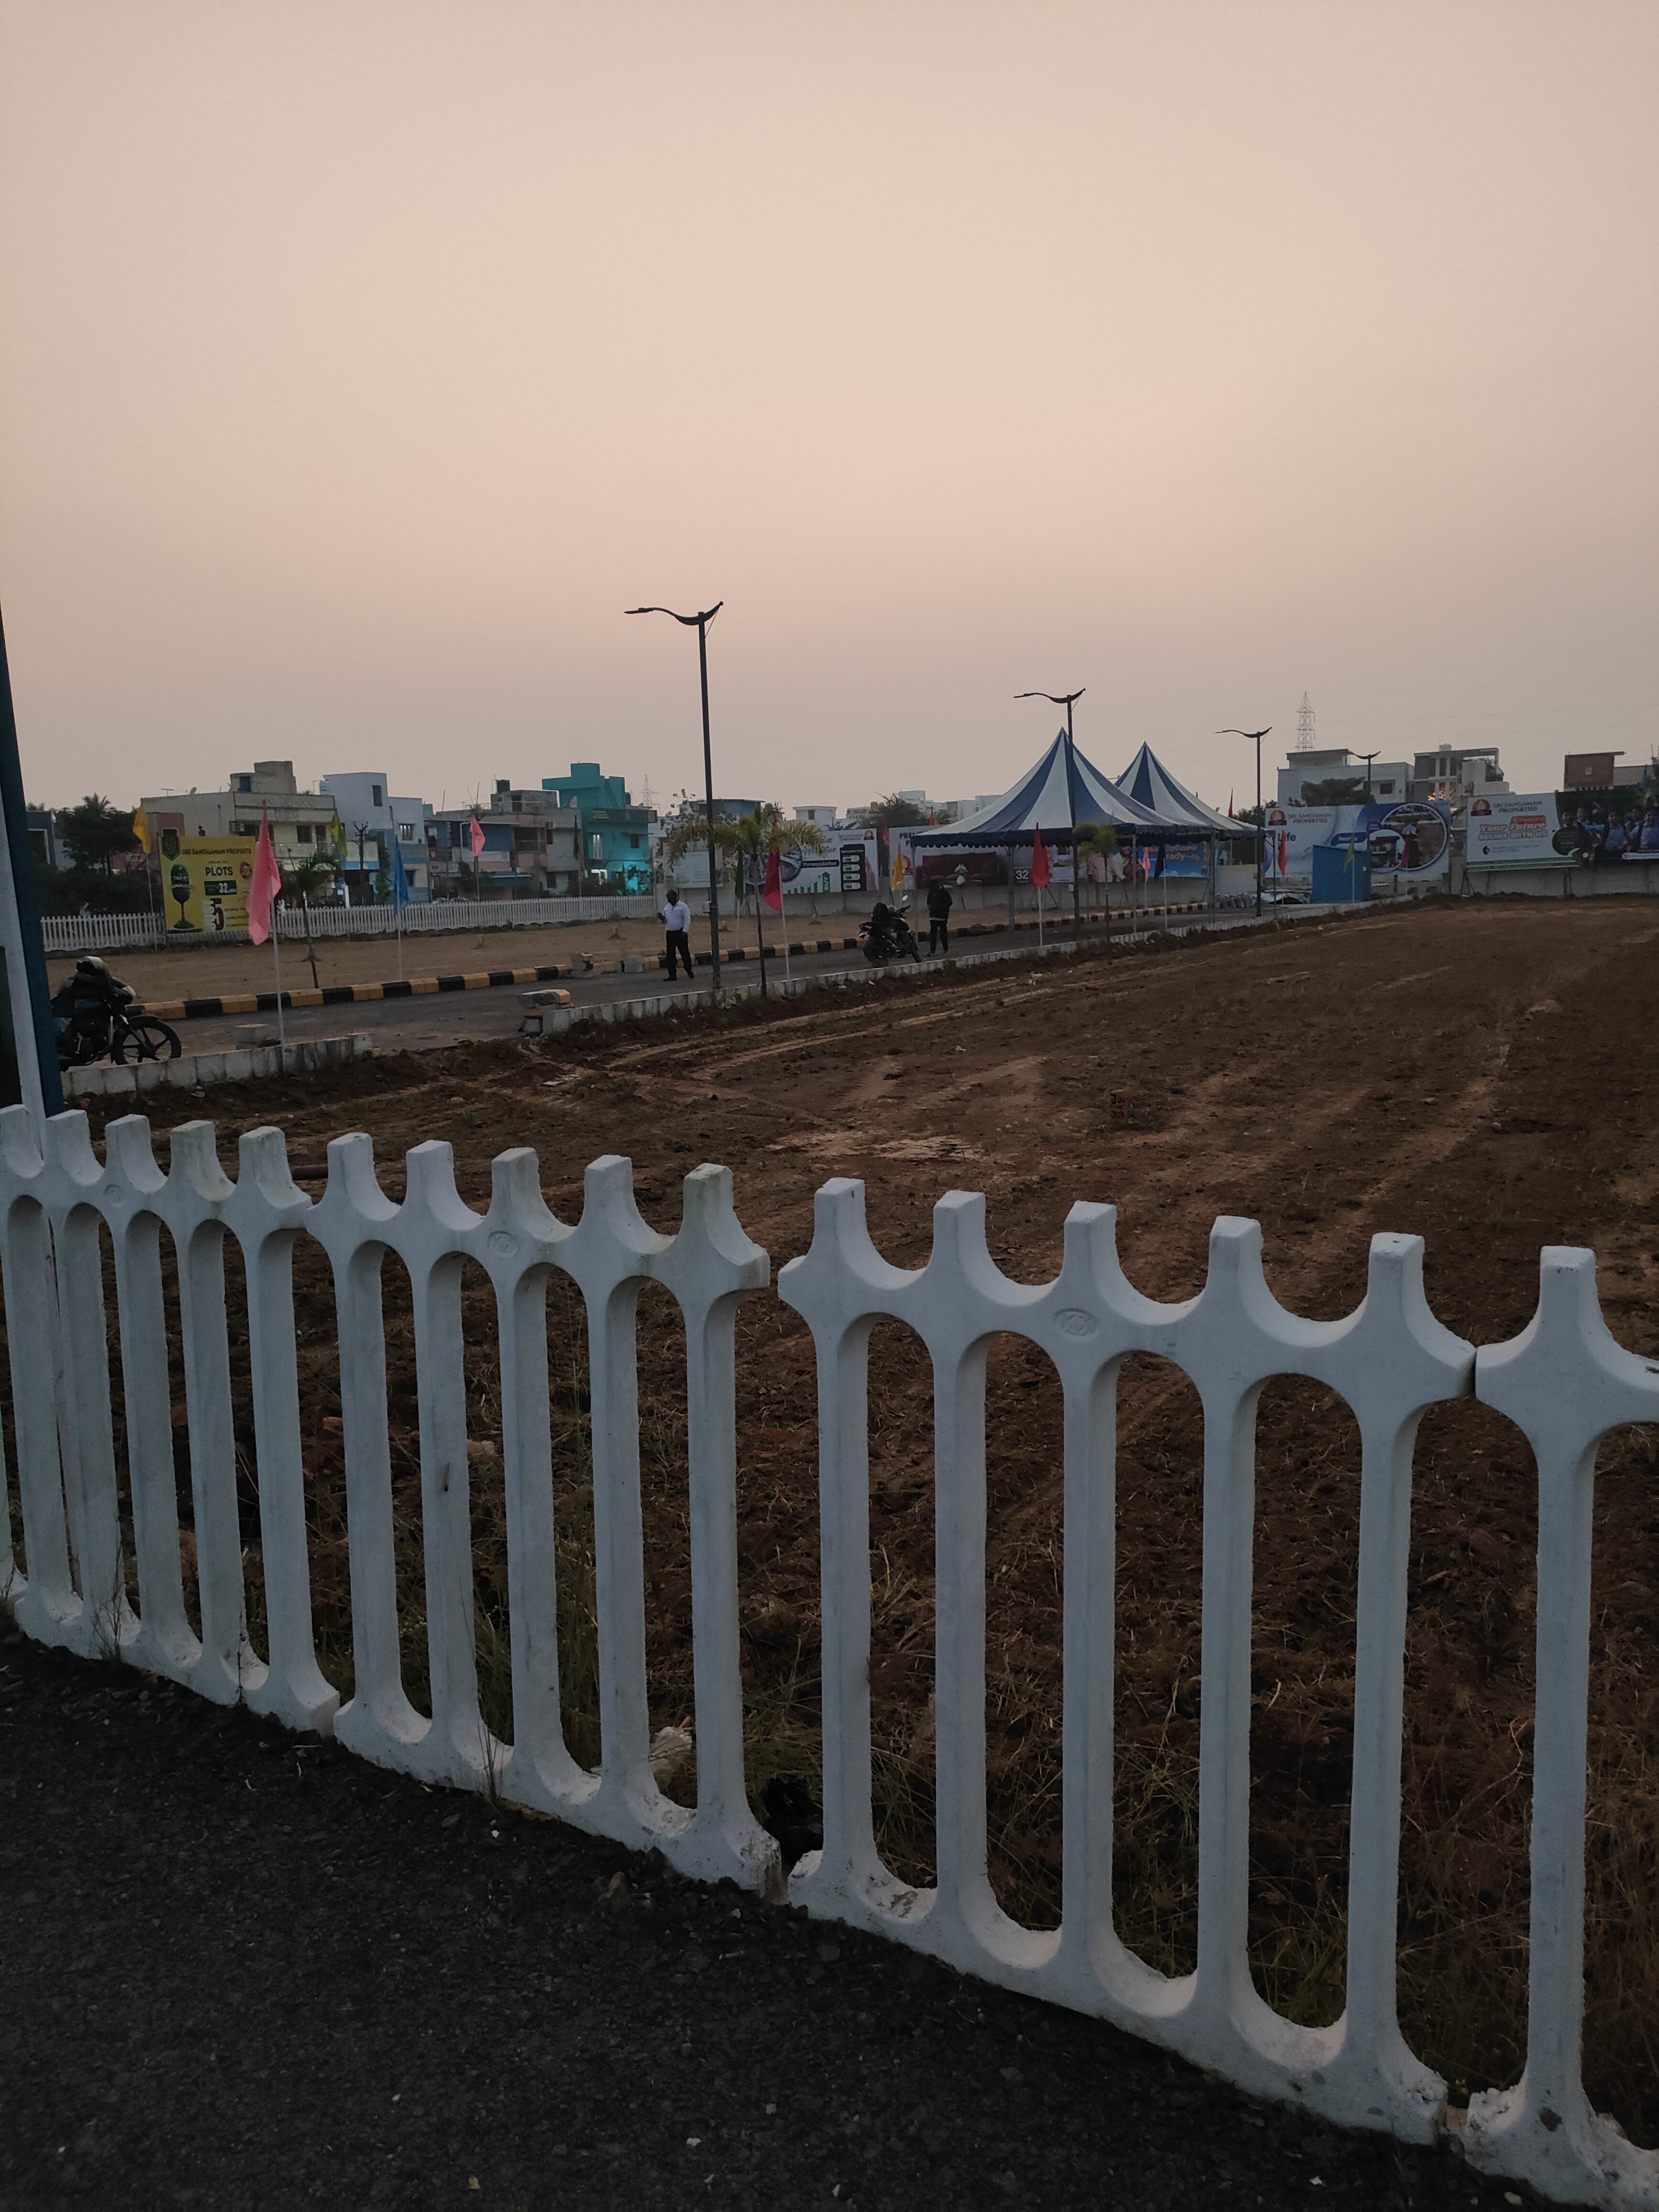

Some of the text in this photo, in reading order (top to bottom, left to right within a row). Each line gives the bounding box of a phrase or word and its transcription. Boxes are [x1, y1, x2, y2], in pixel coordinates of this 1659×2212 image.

[1278, 832, 1296, 841] Lfe
[206, 867, 233, 876] PLOTS
[1016, 870, 1029, 880] 32
